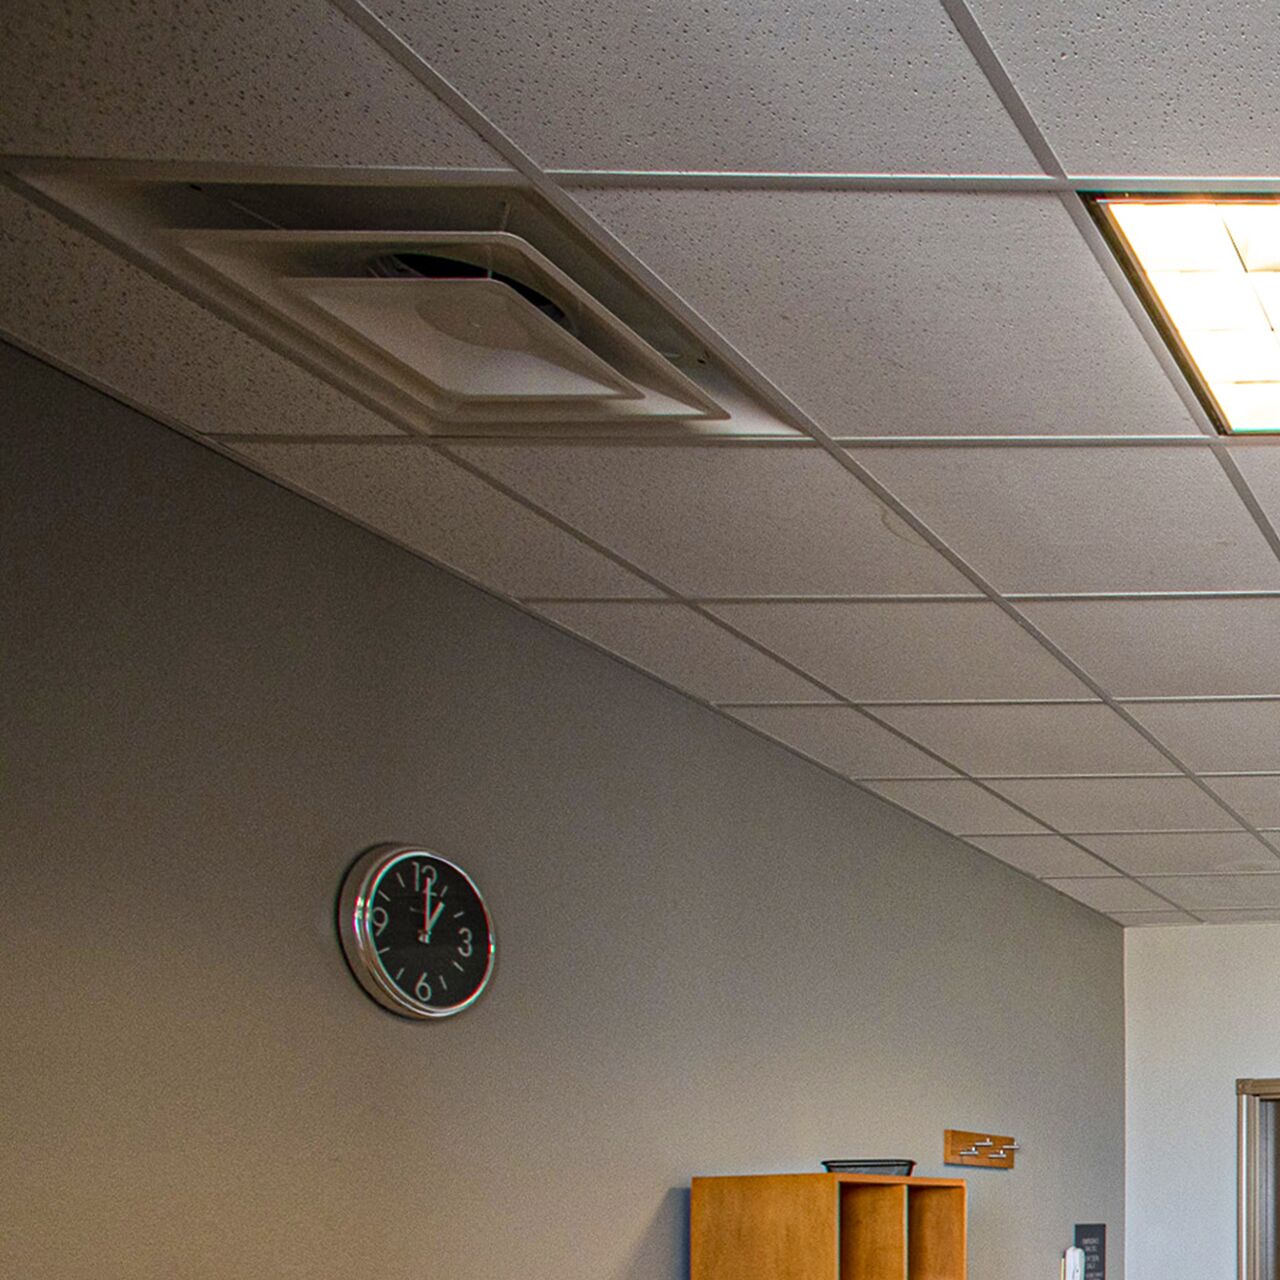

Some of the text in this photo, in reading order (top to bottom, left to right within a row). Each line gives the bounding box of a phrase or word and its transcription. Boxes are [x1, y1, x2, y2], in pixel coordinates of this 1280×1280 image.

[412, 861, 438, 897] 12
[372, 907, 389, 936] 9
[457, 927, 473, 957] 3
[415, 972, 432, 1001] 6
